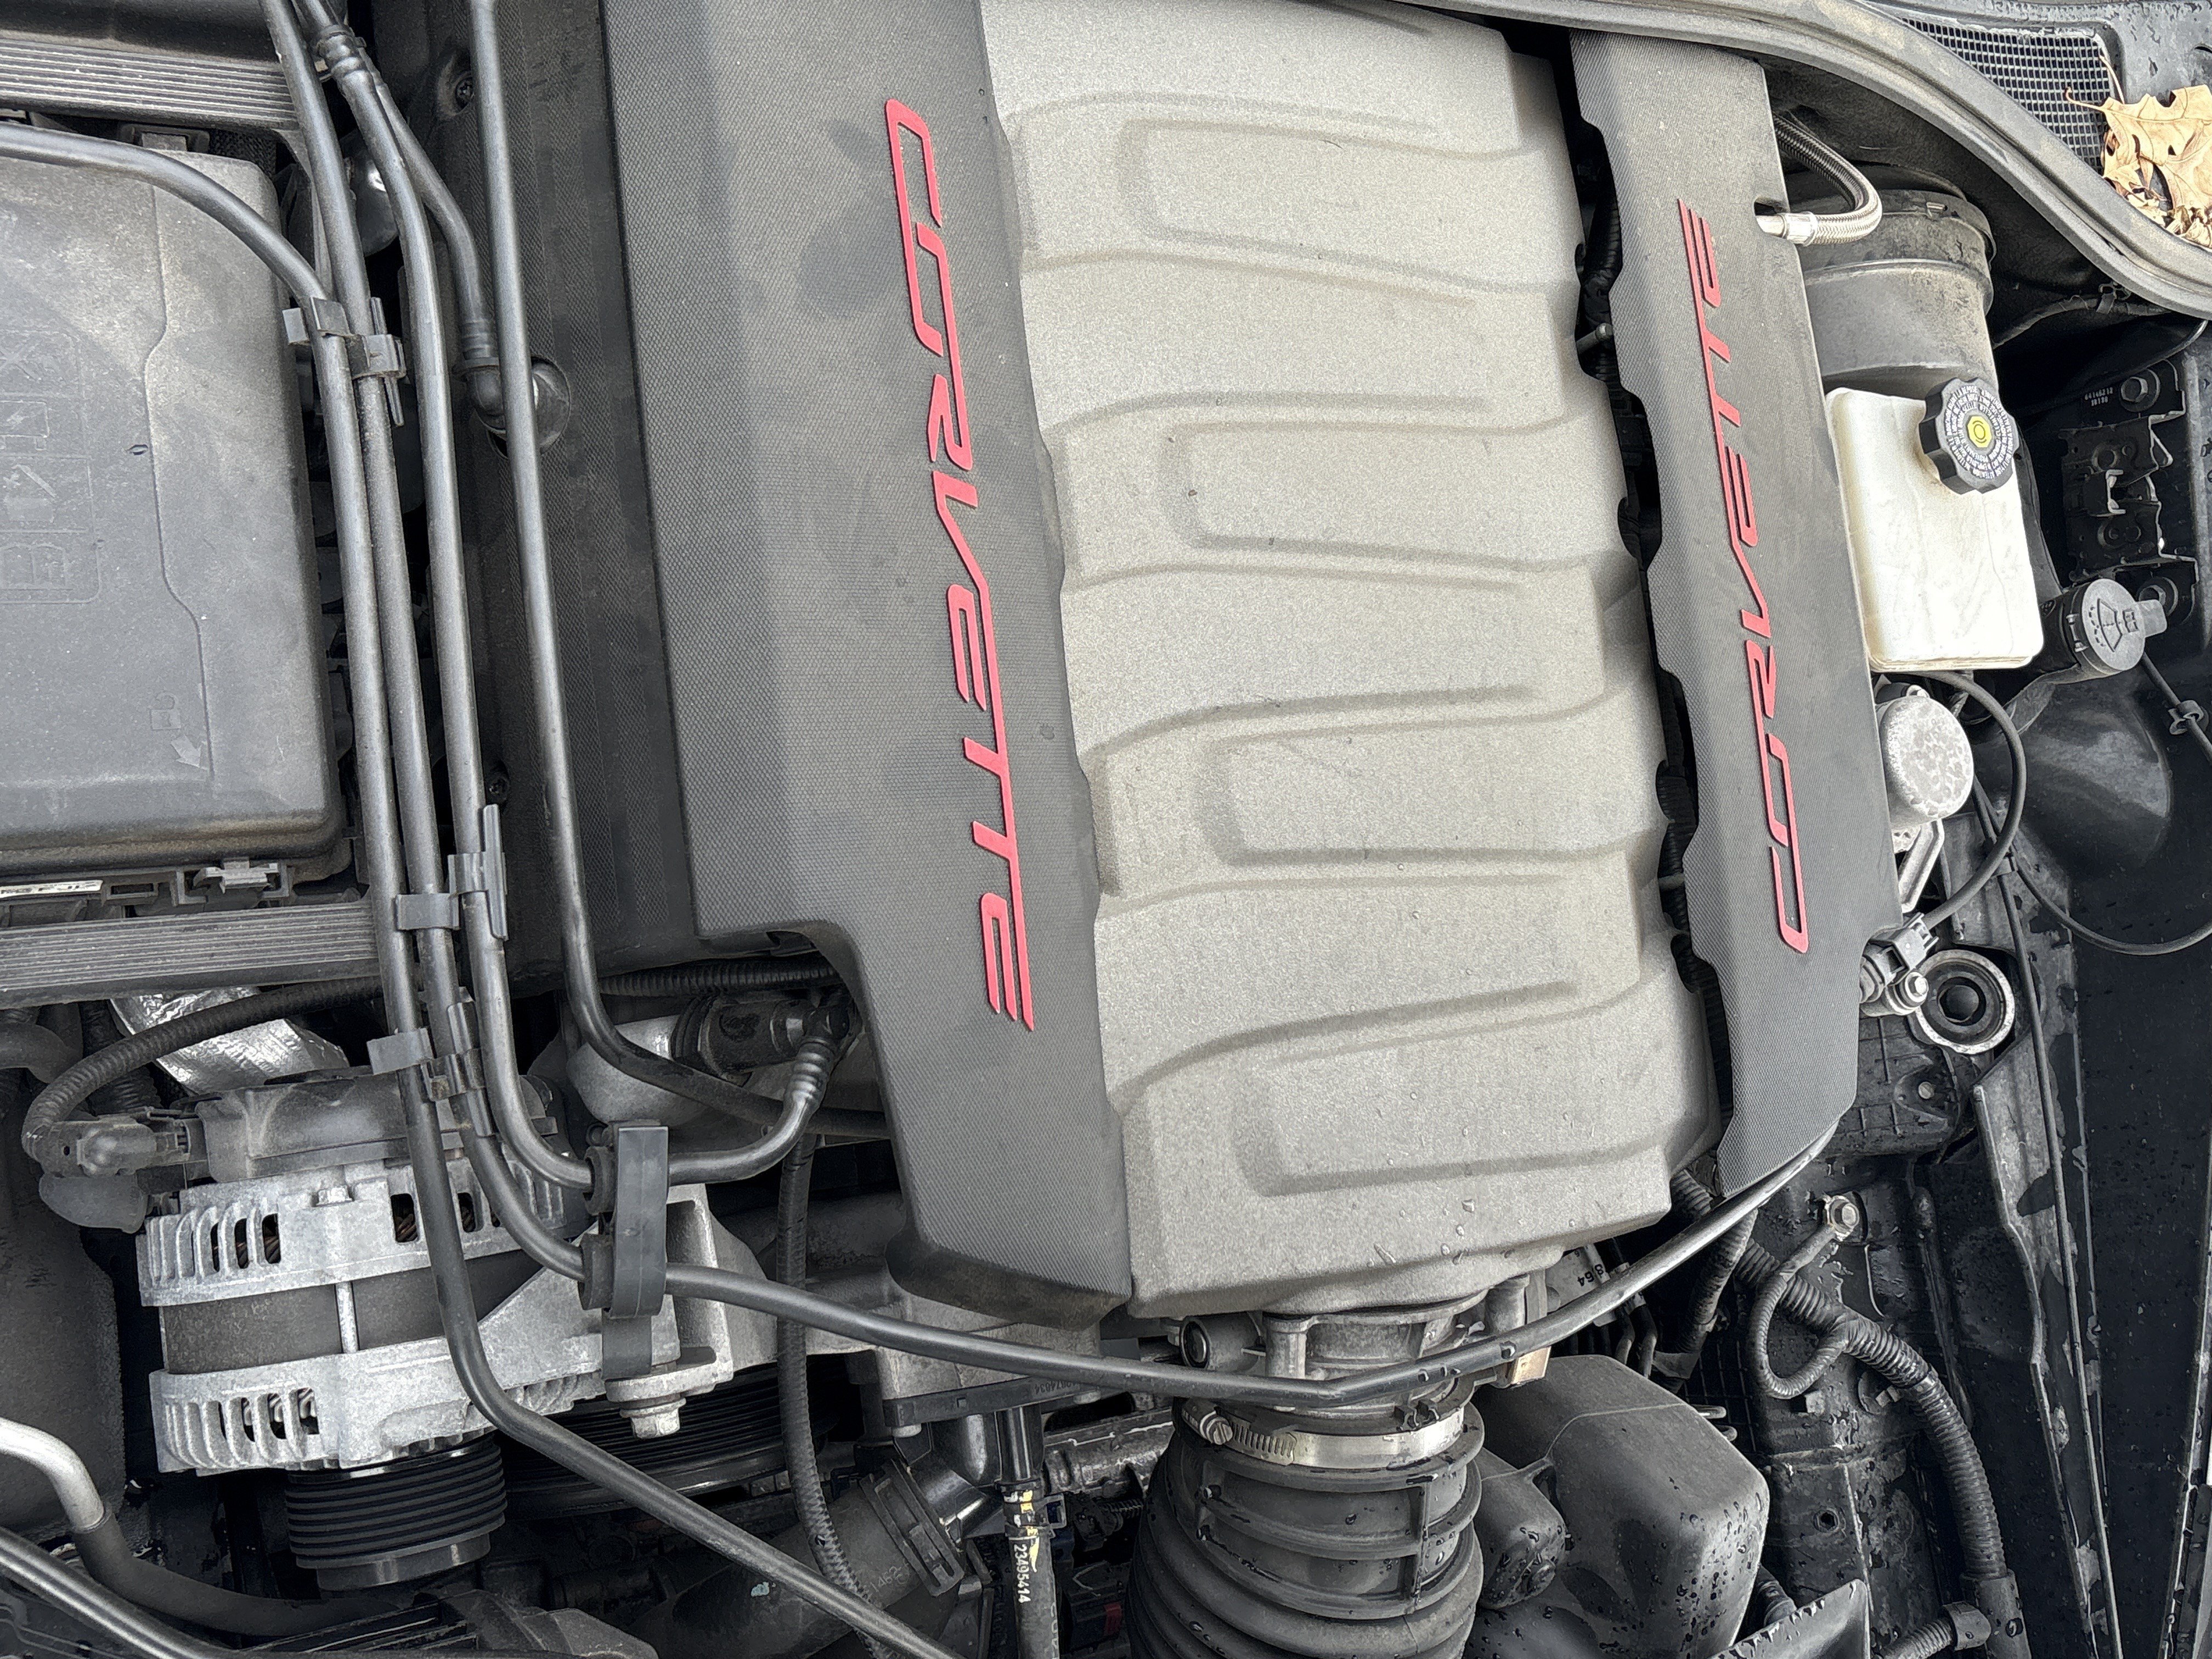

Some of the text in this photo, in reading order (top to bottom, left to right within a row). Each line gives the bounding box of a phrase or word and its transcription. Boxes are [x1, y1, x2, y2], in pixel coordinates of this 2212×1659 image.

[885, 99, 1035, 1031] CORVETTE
[1678, 198, 1809, 953] CORVETTE
[1013, 1543, 1032, 1604] 23495414
